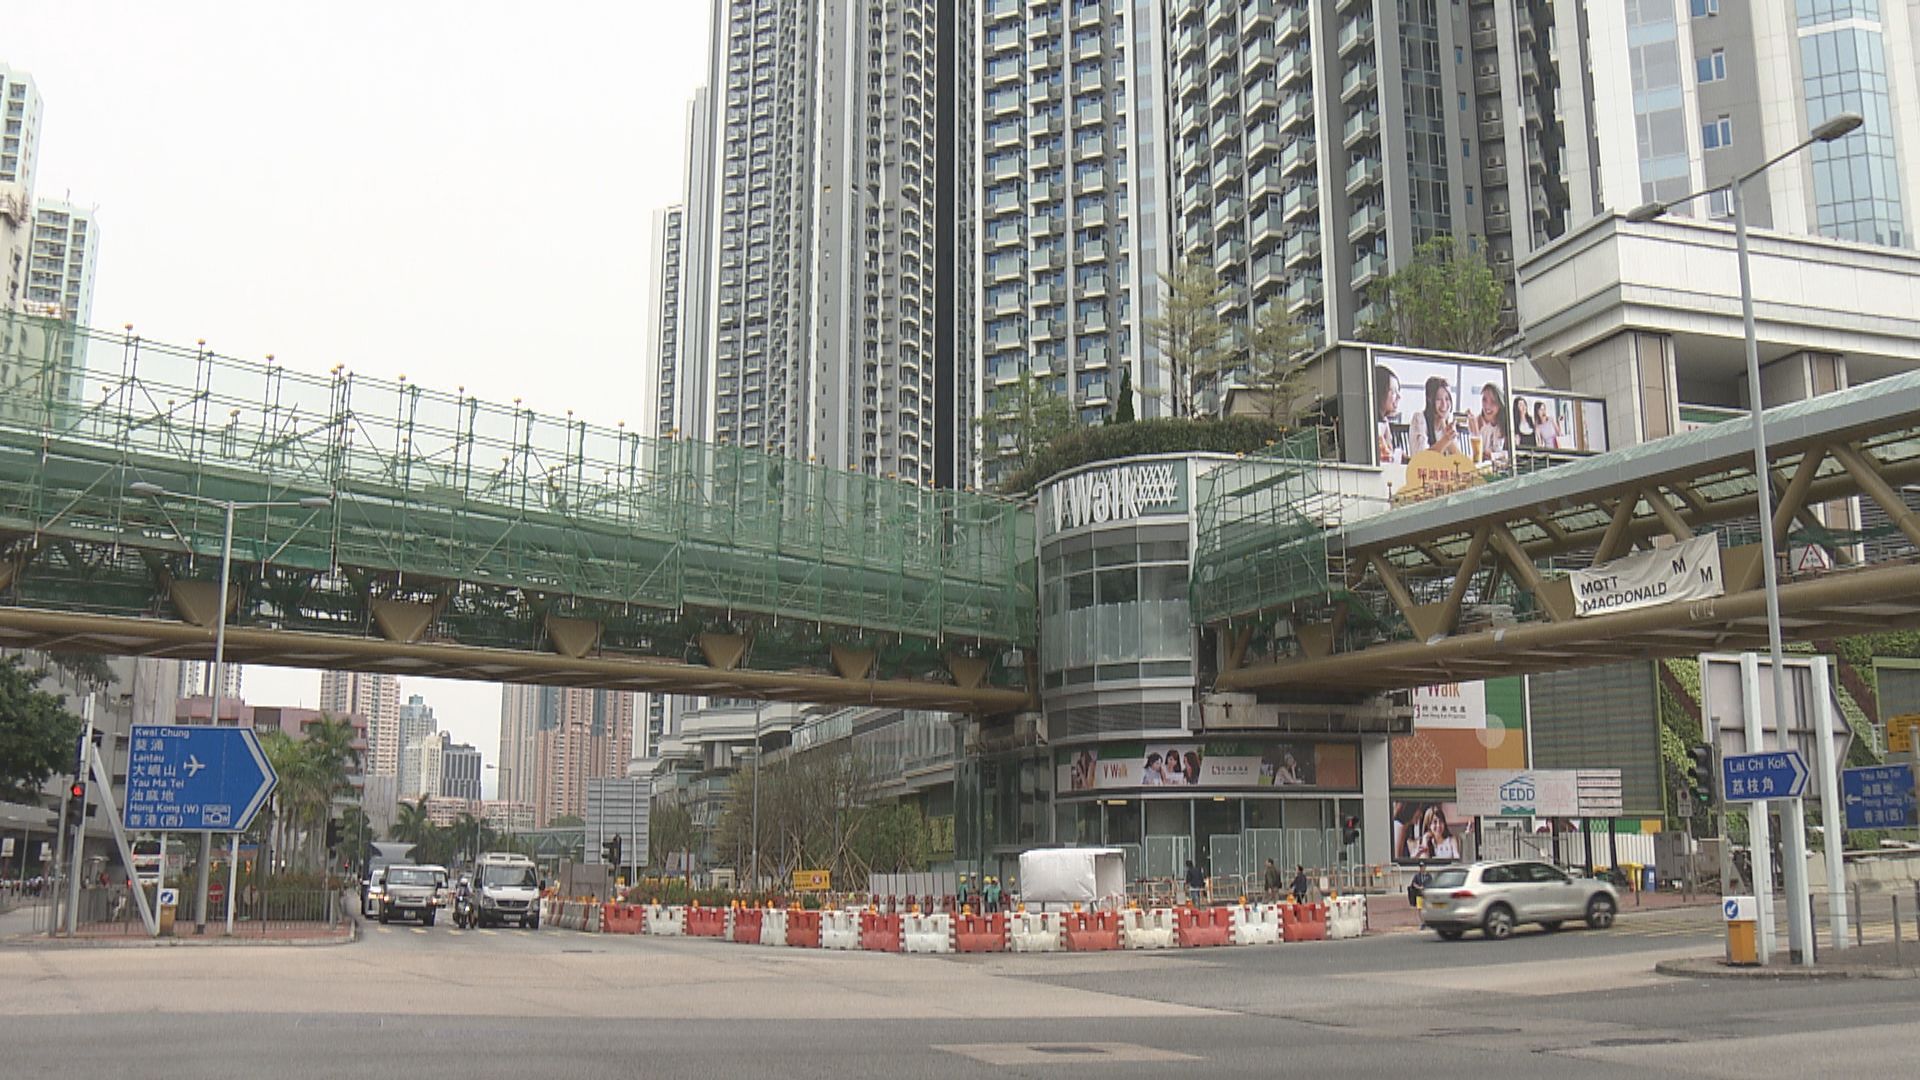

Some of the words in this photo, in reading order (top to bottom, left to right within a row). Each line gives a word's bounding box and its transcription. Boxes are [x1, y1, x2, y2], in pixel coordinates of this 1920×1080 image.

[1580, 575, 1618, 596] MOTT
[1582, 582, 1667, 612] MACDONALD
[135, 728, 157, 737] Kwai
[160, 728, 190, 739] Chung
[133, 752, 164, 763] Lantau
[1729, 760, 1745, 773] Lai
[1748, 758, 1764, 771] Chi
[1767, 756, 1787, 769] Kok
[132, 778, 149, 788] Yau
[152, 778, 167, 787] Ma
[171, 778, 184, 788] Tei
[1731, 775, 1774, 795] 荔枝角
[1500, 788, 1536, 802] CEDD
[129, 802, 153, 813] Hong
[156, 803, 180, 814] Kong
[183, 804, 199, 815] (W)
